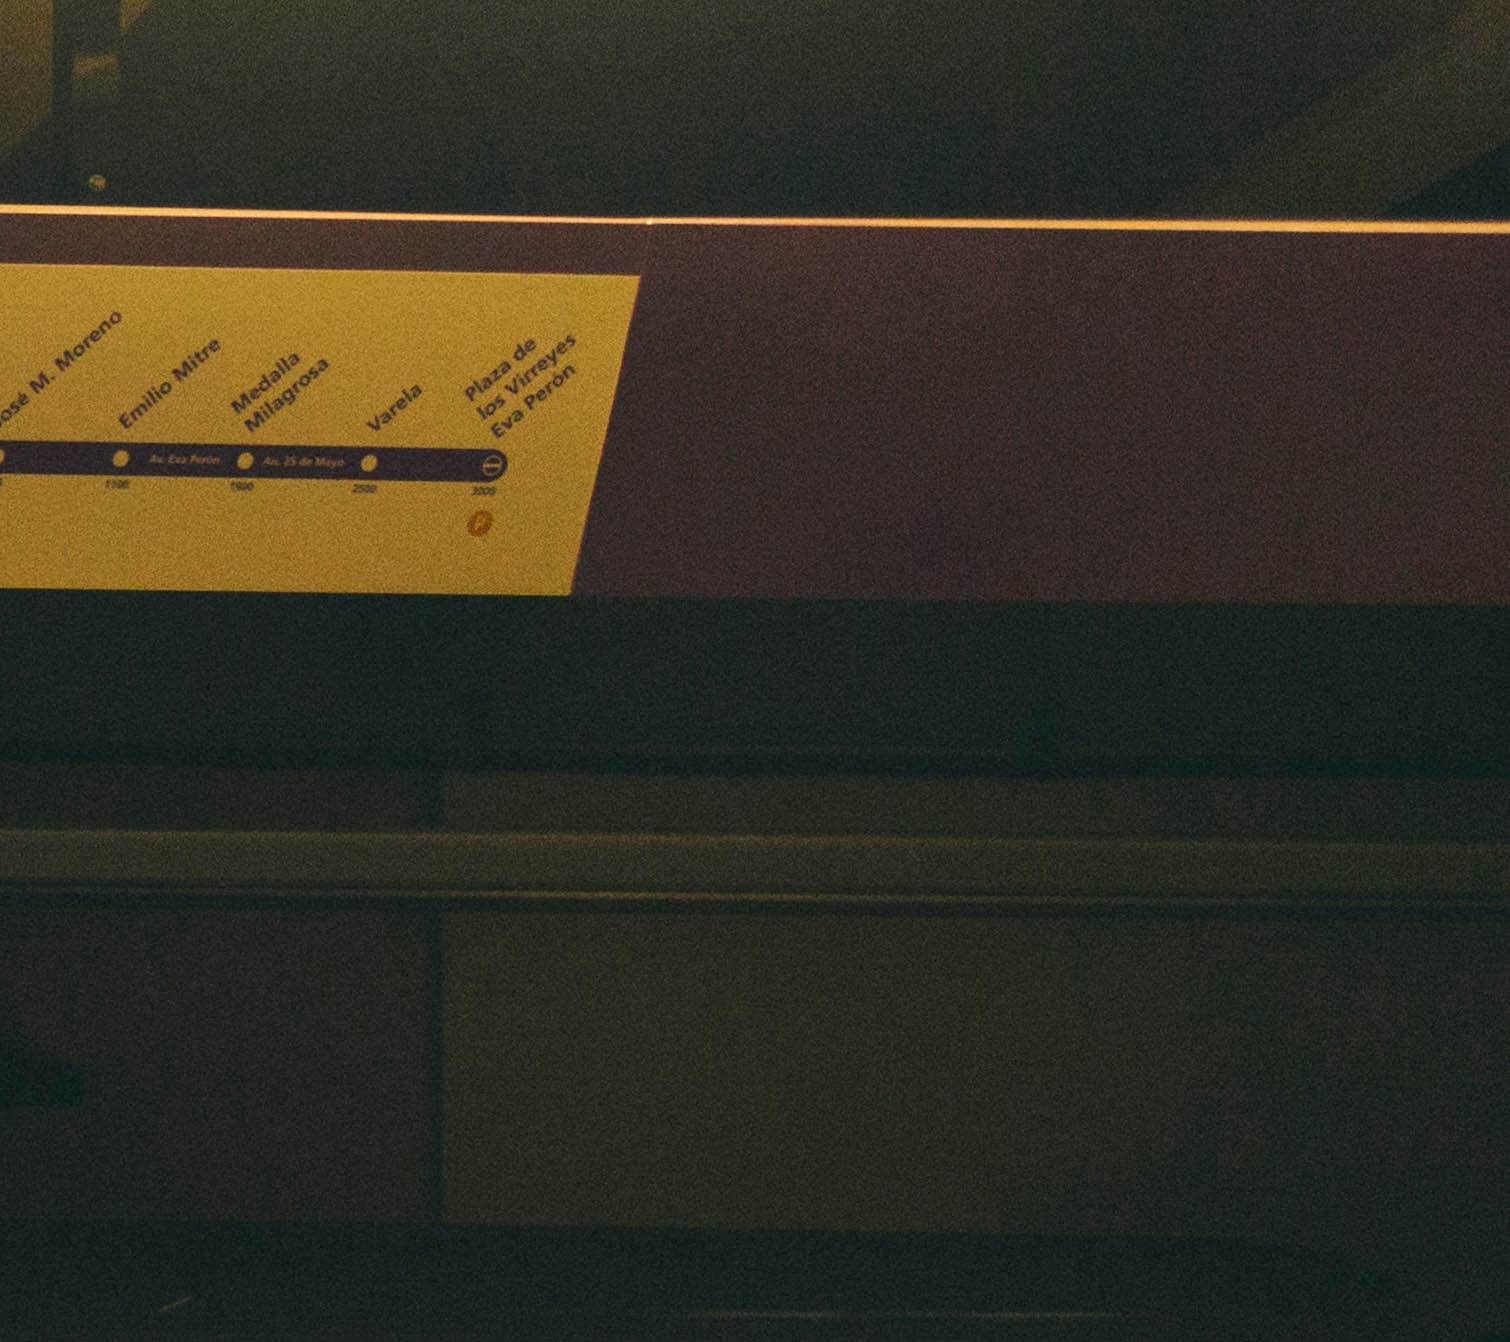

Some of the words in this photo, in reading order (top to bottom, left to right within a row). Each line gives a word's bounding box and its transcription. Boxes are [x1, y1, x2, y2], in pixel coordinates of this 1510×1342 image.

[28, 372, 56, 394] M.
[53, 310, 123, 373] Moreno
[118, 379, 173, 430] Emilio
[171, 338, 221, 383] Mitre
[230, 352, 301, 415] Medalla
[465, 360, 513, 403] Plaza
[513, 337, 538, 362] de
[476, 396, 506, 421] los
[504, 334, 577, 396] Virreyes
[243, 357, 330, 433] Milagrosa
[367, 383, 423, 432] Varela
[490, 404, 525, 439] Eva
